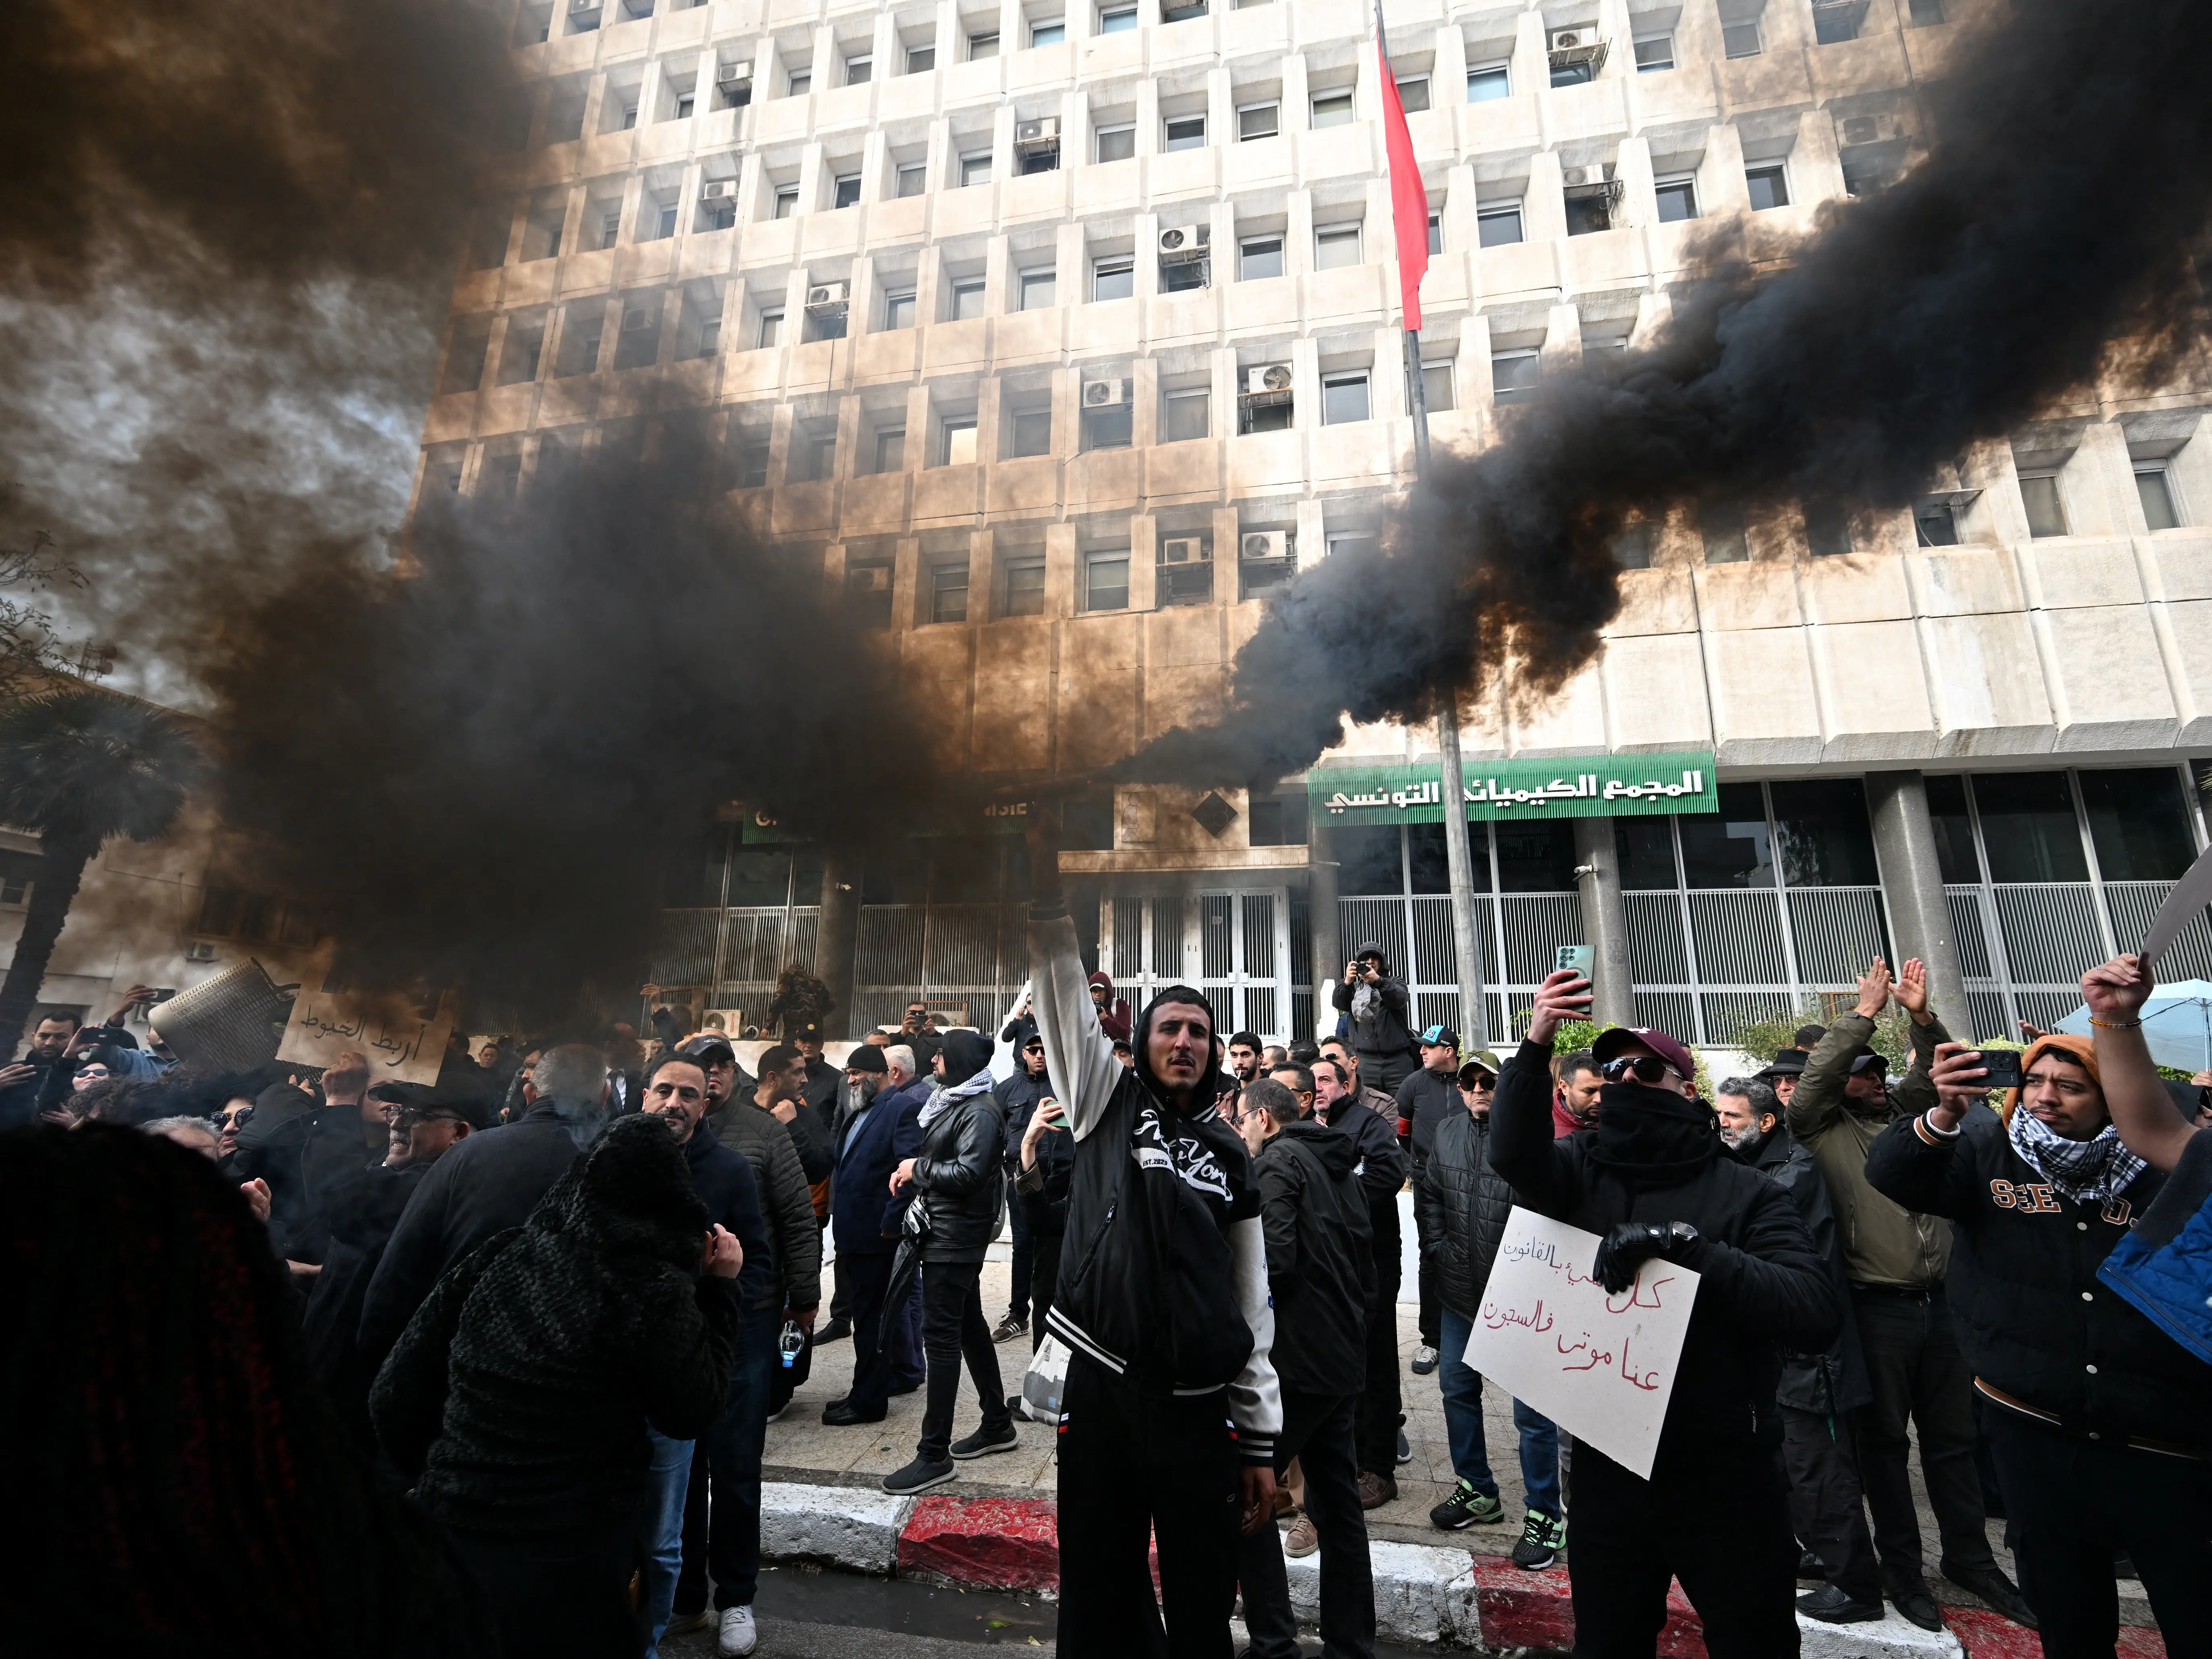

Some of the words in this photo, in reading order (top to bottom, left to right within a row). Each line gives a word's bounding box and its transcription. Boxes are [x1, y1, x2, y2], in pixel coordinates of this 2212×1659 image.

[1324, 781, 1439, 814] التونسي
[1603, 770, 1702, 801] المجمع
[301, 1005, 366, 1042] الخيوط
[1990, 1179, 2061, 1213] SEE
[1606, 1272, 1675, 1313] كل
[1484, 1300, 1553, 1332] فالسجون
[1622, 1337, 1659, 1391] عنا
